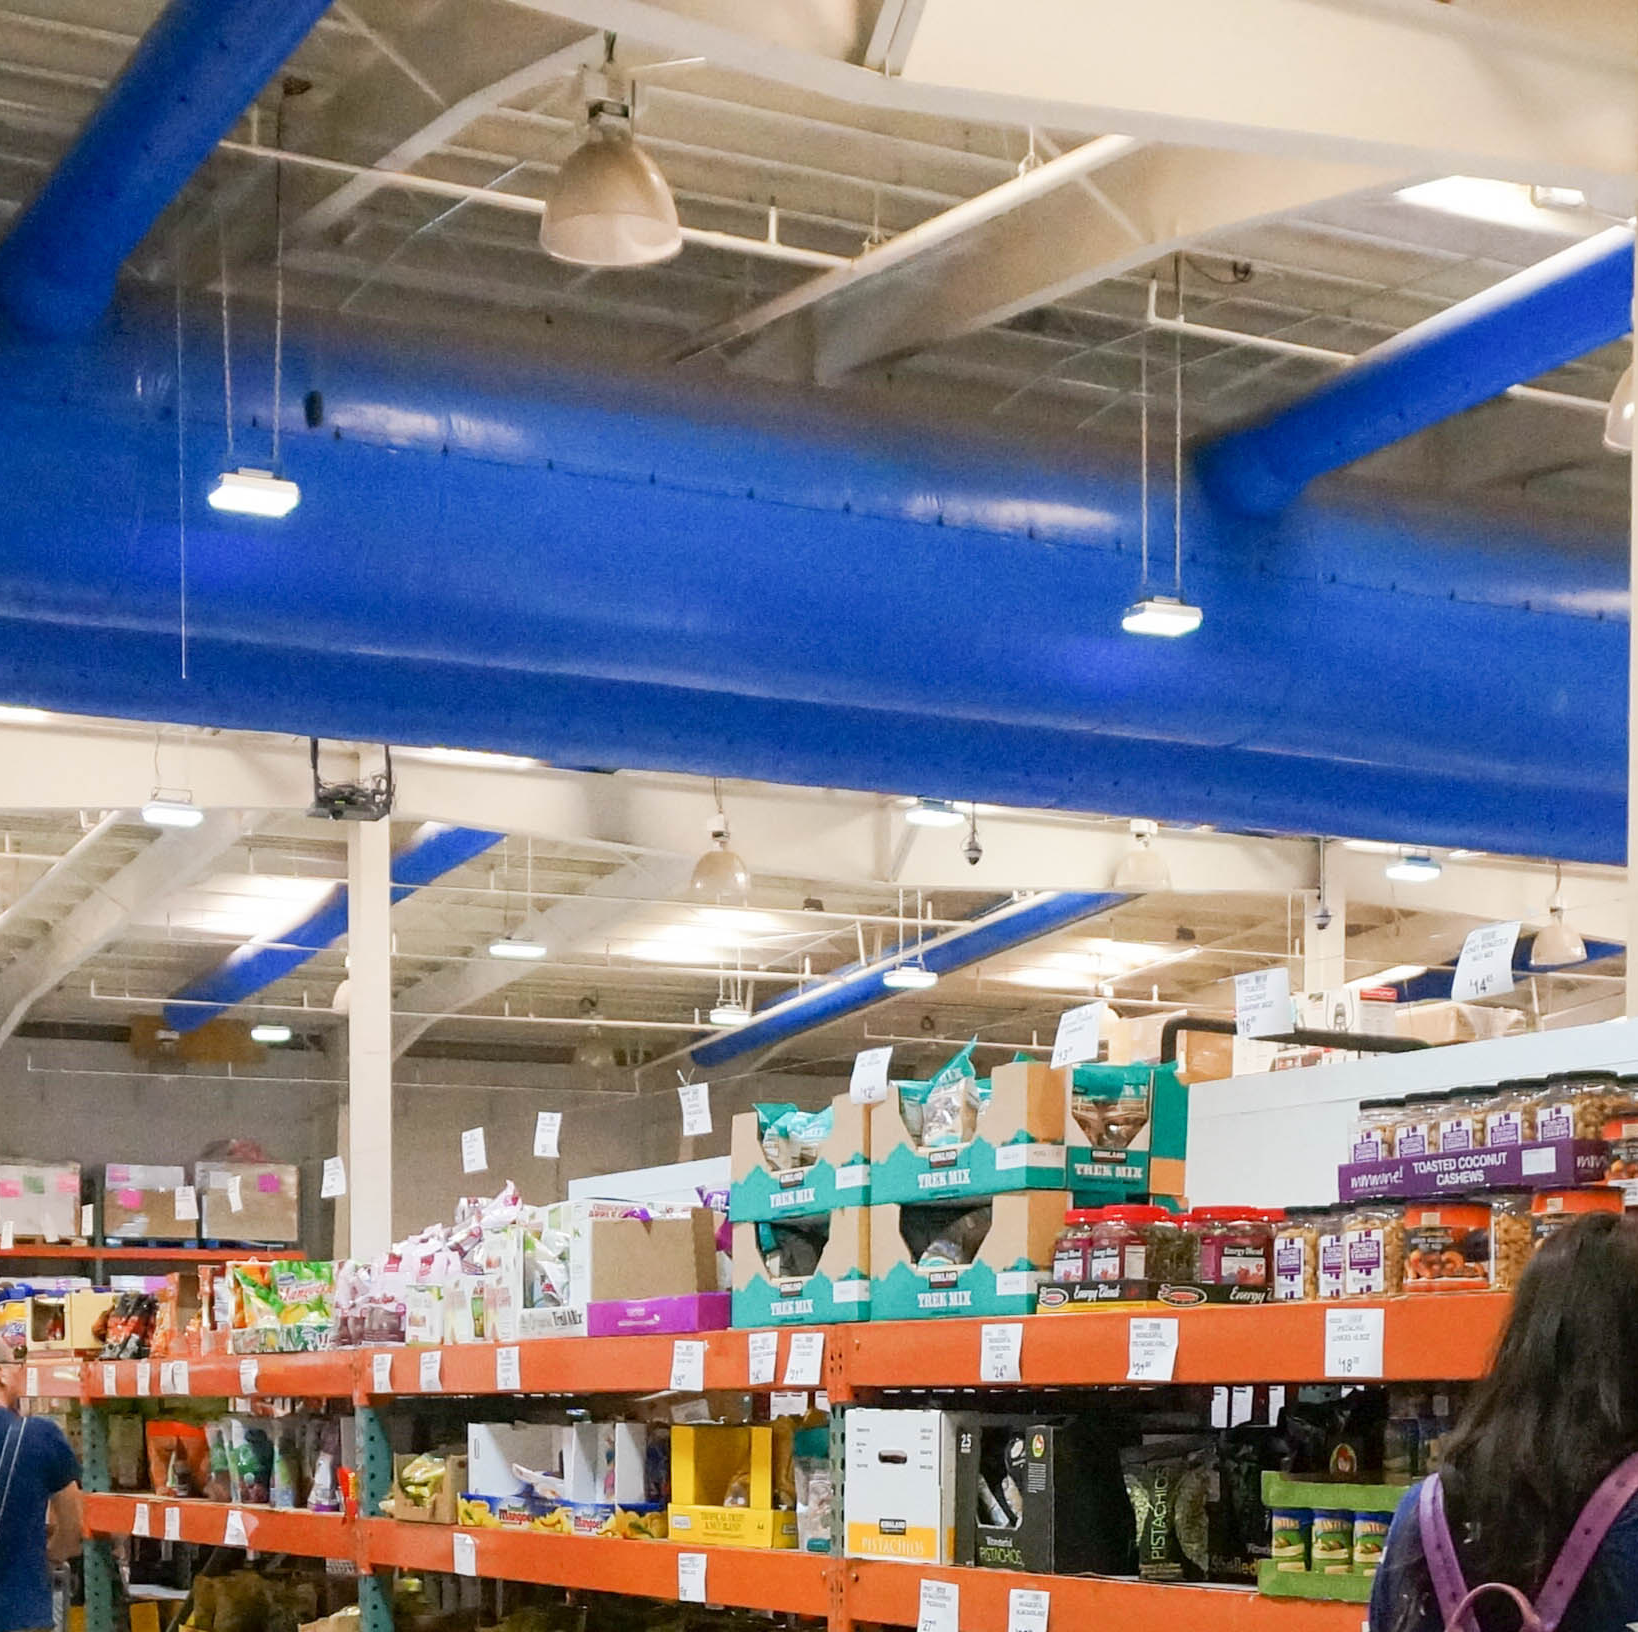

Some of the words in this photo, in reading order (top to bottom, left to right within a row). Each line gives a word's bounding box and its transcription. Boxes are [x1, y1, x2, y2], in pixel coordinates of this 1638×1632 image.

[1413, 1158, 1456, 1173] TOASTED
[1458, 1152, 1507, 1168] COCONUT
[1436, 1170, 1484, 1186] CASHEWS
[861, 1537, 924, 1556] PISTACHIOS
